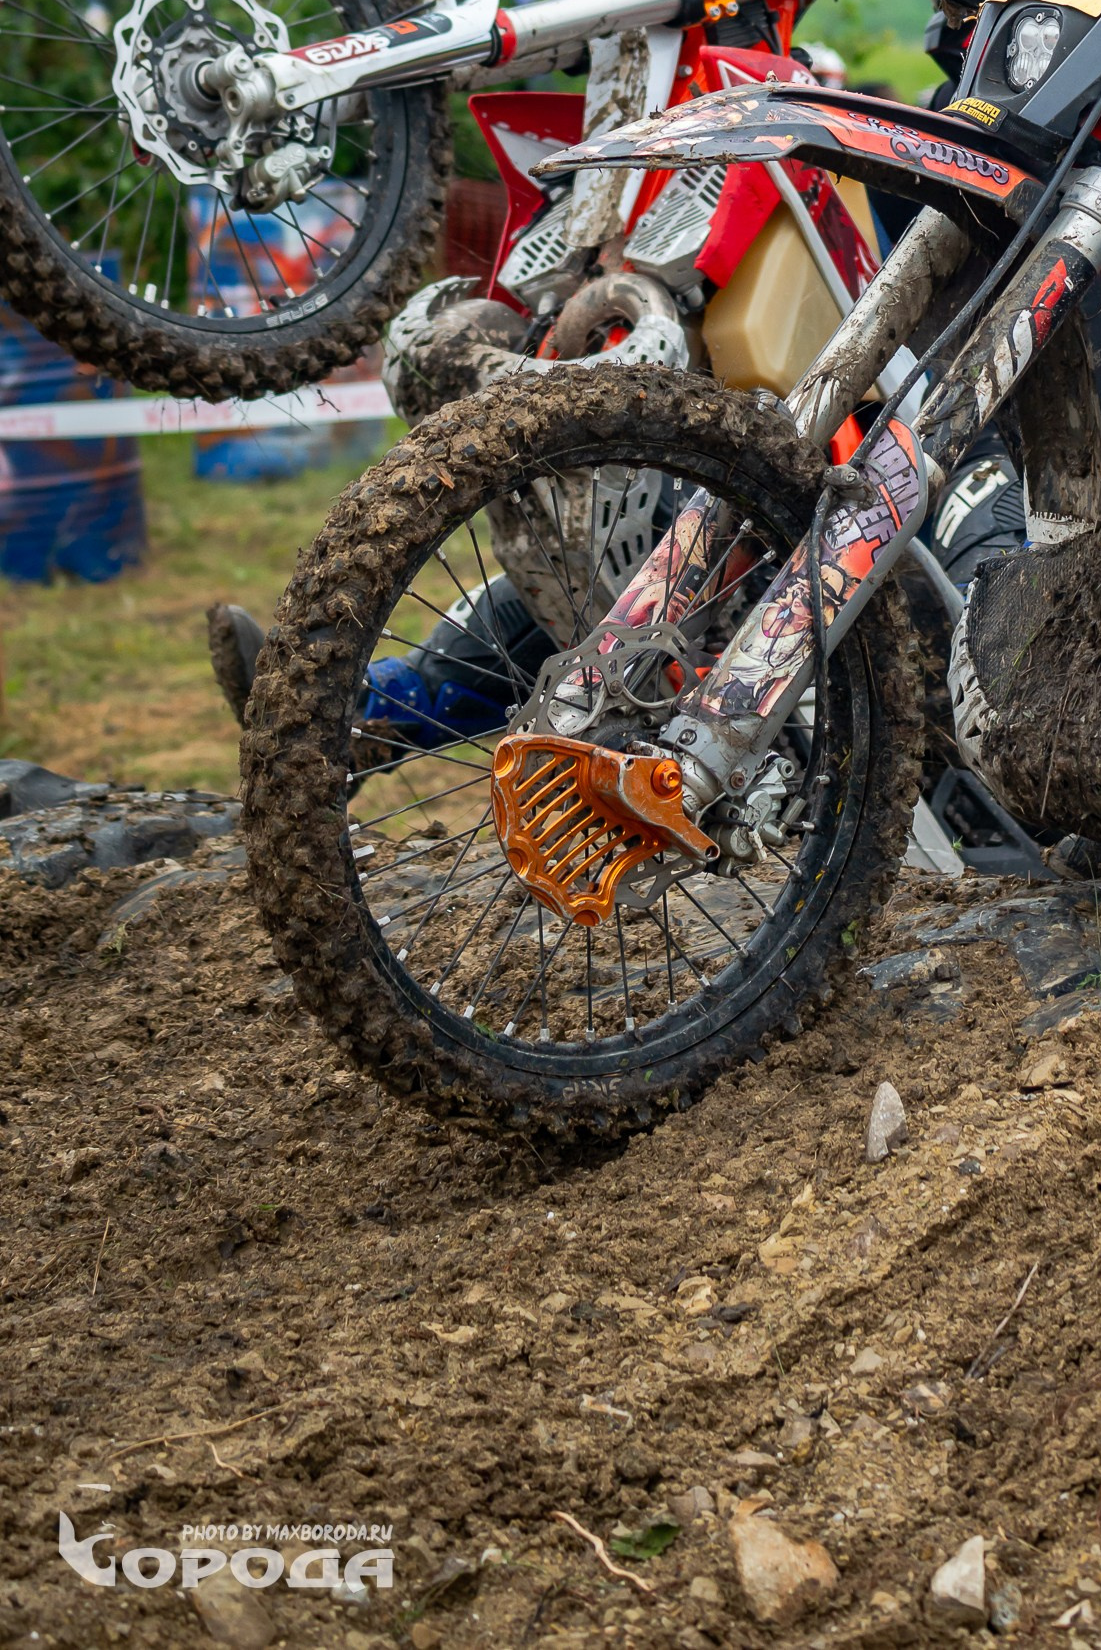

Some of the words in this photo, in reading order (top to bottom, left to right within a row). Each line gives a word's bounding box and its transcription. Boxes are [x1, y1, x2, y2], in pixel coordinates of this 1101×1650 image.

[304, 31, 391, 65] 6DAYS
[958, 104, 996, 127] ELEMENT
[961, 97, 1001, 118] ENDURO
